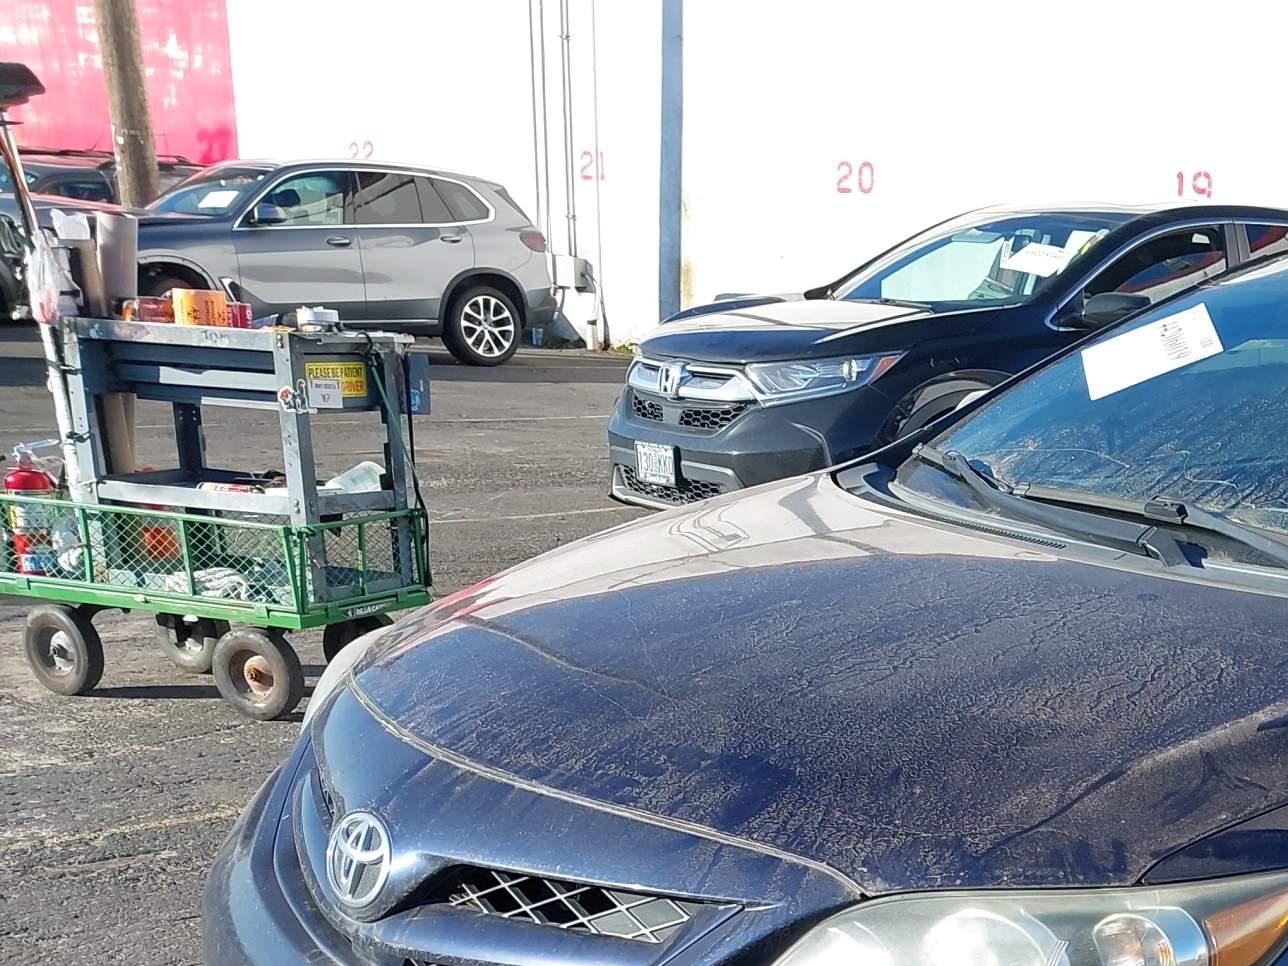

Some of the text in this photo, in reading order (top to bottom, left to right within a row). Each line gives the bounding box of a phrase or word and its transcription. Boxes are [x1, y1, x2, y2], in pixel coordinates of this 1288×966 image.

[580, 150, 606, 181] 21
[837, 161, 874, 193] 20
[1176, 171, 1213, 200] 19
[308, 367, 363, 378] PLEASE BE PATIENT
